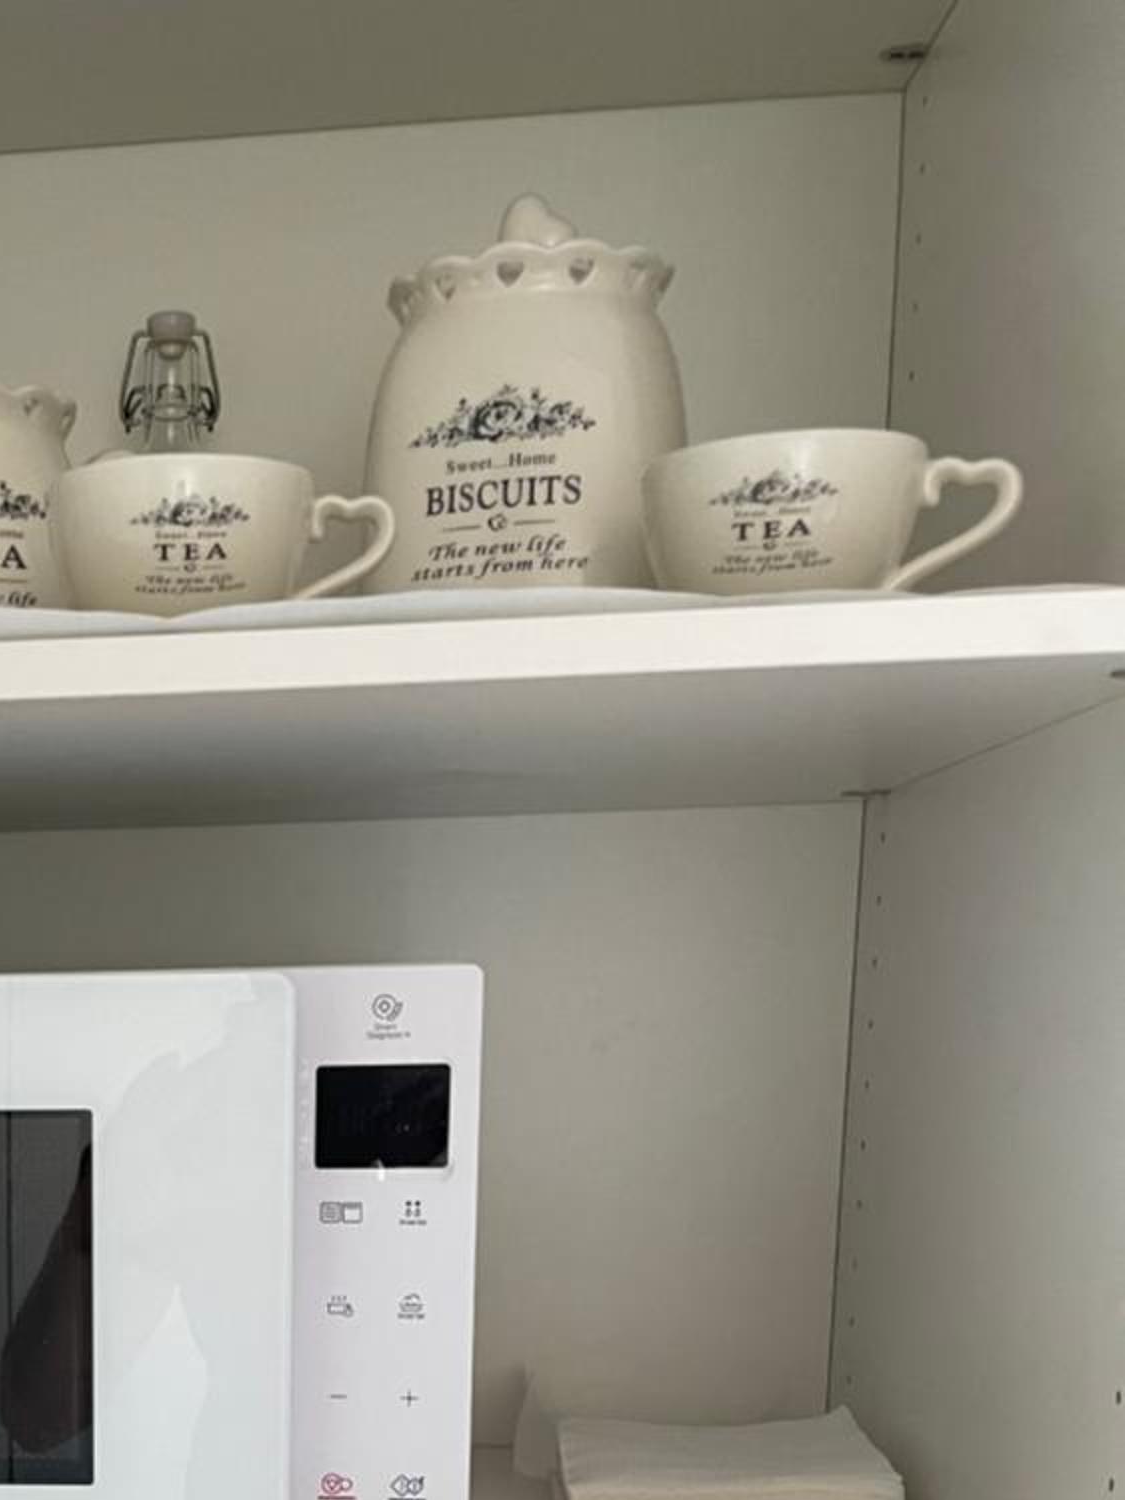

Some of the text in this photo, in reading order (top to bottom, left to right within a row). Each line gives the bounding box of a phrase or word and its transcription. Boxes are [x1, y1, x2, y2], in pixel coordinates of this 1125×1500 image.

[426, 474, 583, 517] BISCUITS
[731, 519, 811, 541] TEA
[153, 542, 228, 561] TEA
[428, 533, 567, 561] The new life
[412, 555, 589, 582] starts from here
[7, 590, 39, 608] life
